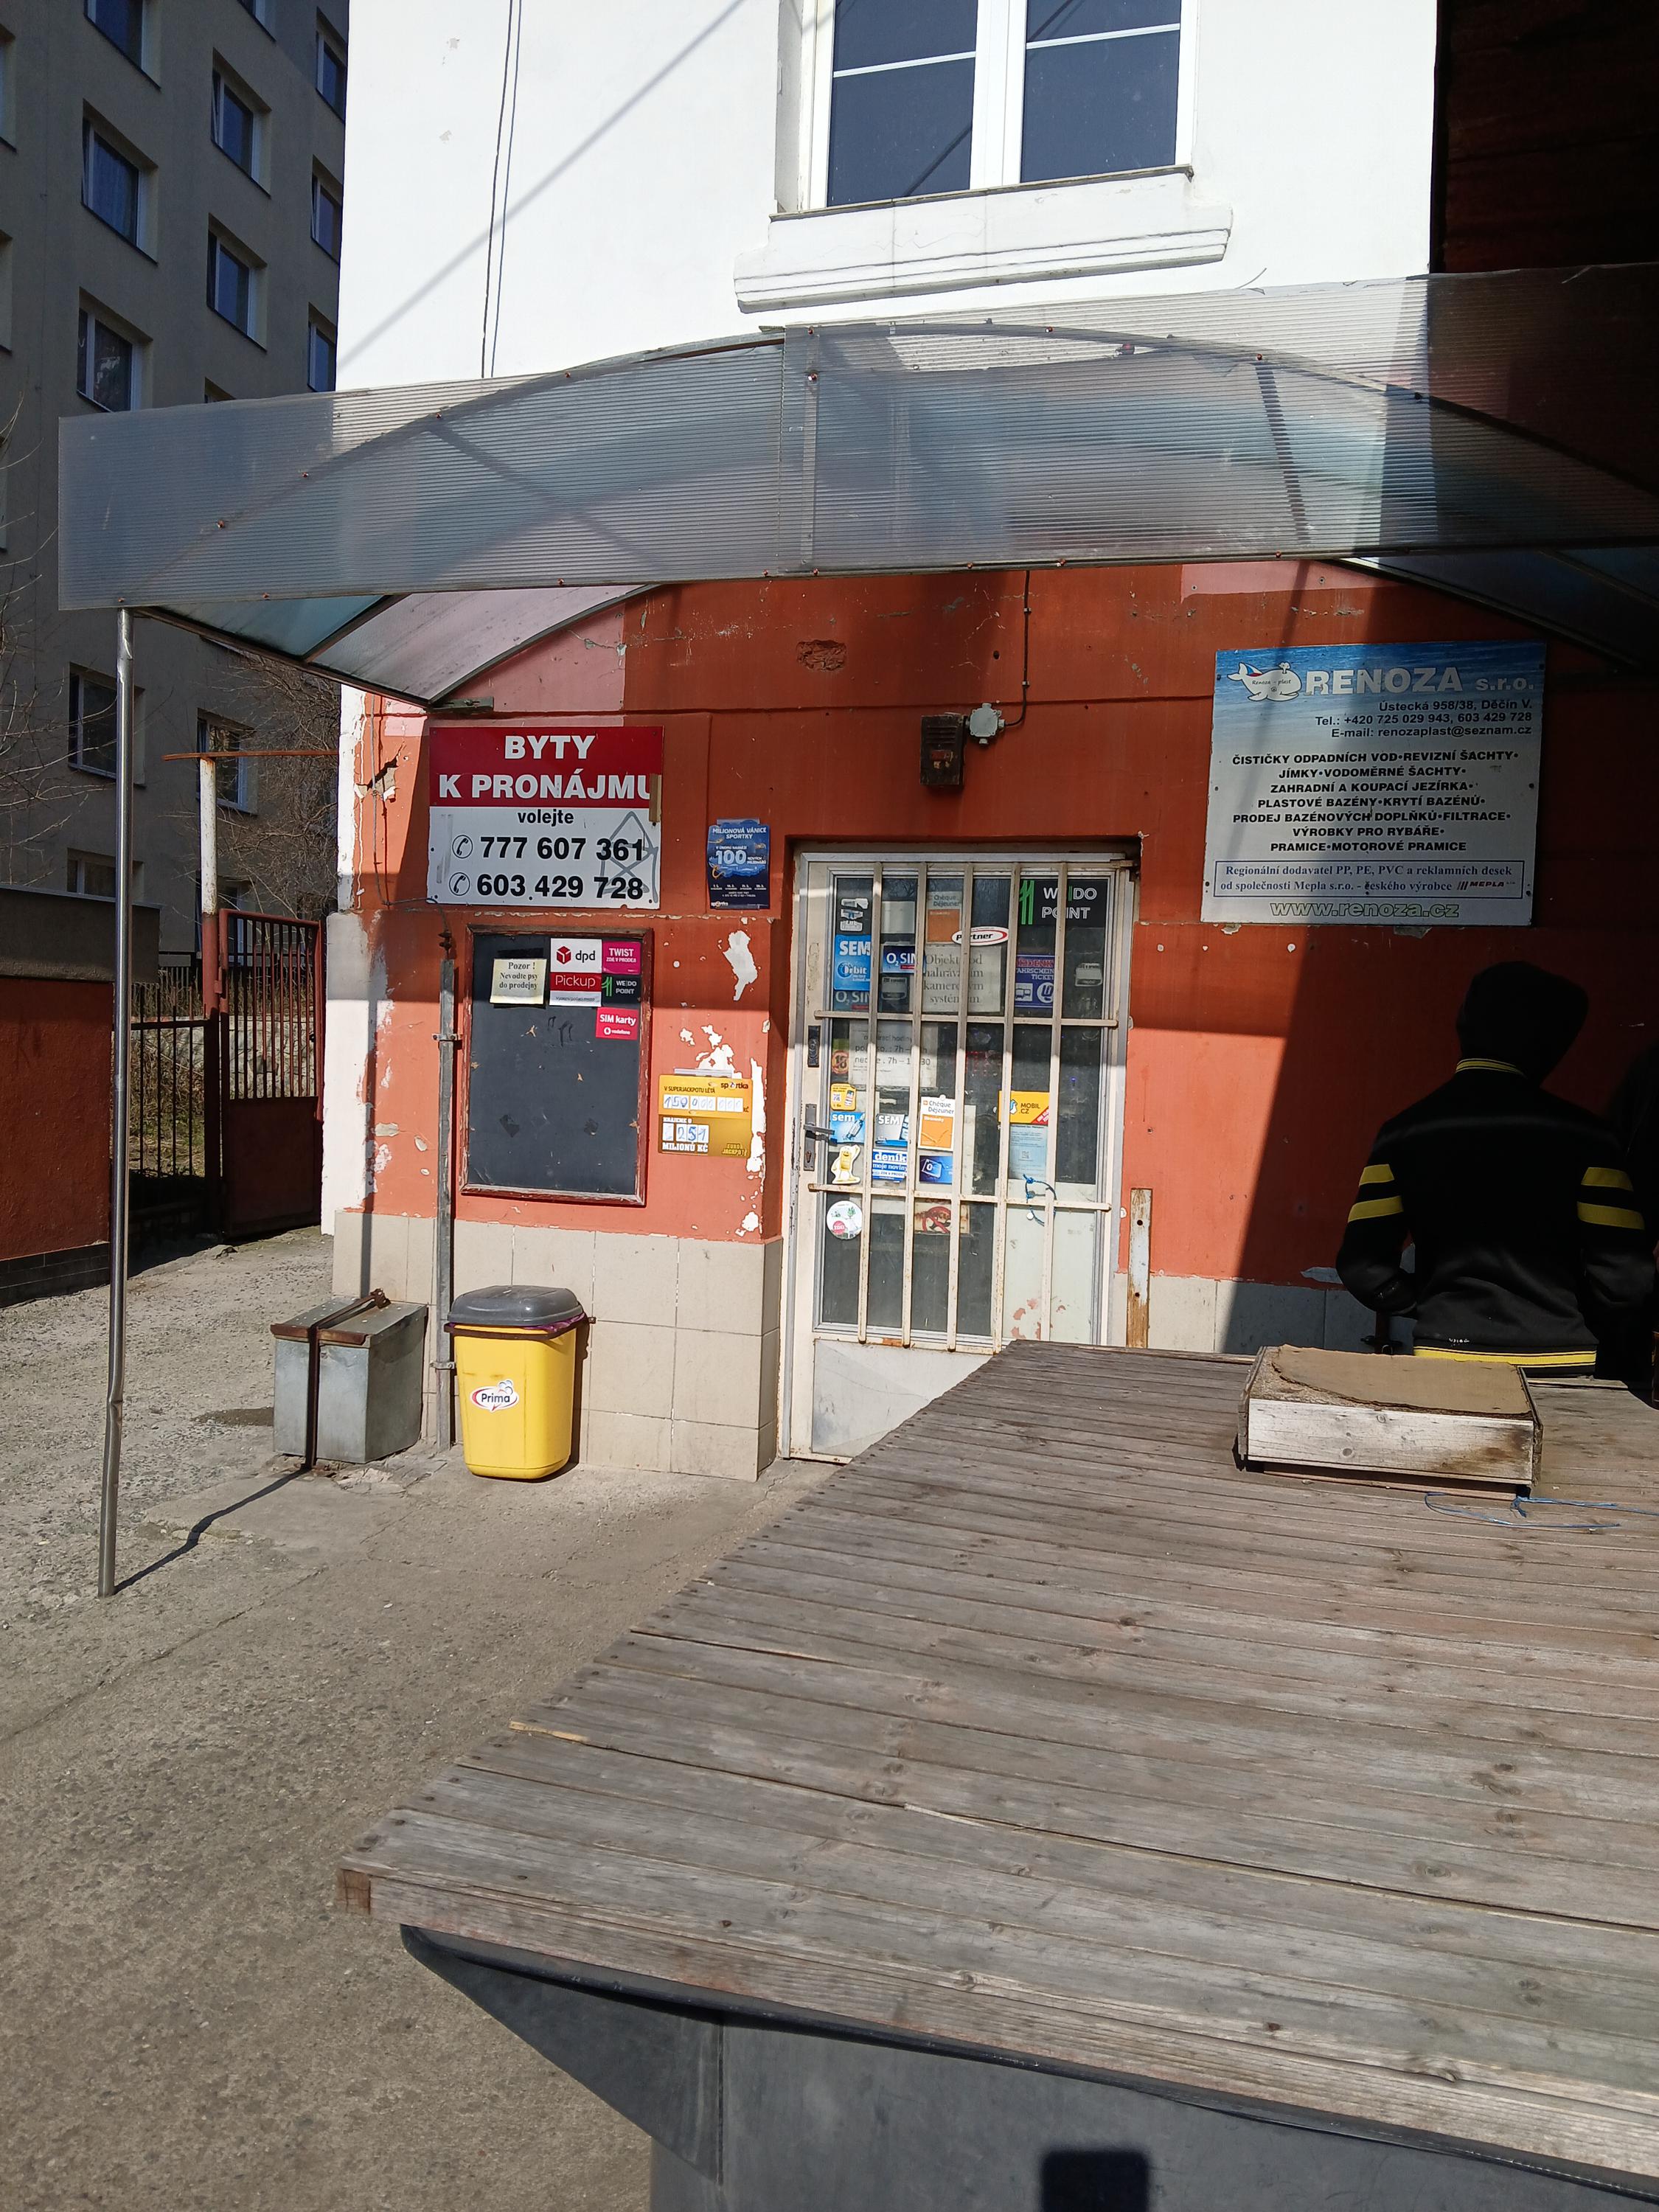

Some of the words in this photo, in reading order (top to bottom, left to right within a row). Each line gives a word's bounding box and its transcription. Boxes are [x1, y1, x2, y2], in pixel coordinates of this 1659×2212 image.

[1304, 667, 1463, 696] RENOZA
[1475, 677, 1534, 691] s.r.o.
[1379, 700, 1428, 712] Ústecká
[1433, 701, 1477, 712] 958/38,
[1481, 700, 1517, 709] Děčín
[1522, 700, 1532, 709] V.
[1315, 716, 1340, 726] Tel.:
[1344, 715, 1373, 725] +420
[1377, 714, 1399, 724] 725
[1402, 714, 1424, 723] 029
[1427, 713, 1453, 724] 943,
[1457, 713, 1479, 723] 603
[1484, 712, 1506, 722] 429
[1510, 712, 1532, 722] 728
[1332, 727, 1374, 737] E-mail:
[1378, 726, 1531, 737] renozaplast@seznam.cz
[504, 735, 596, 759] BYTY
[1232, 754, 1290, 765] ČISTIČKY
[1293, 751, 1367, 763] ODPADNÍCH
[439, 774, 462, 798] K
[472, 768, 650, 799] PRONÁJMU
[1270, 781, 1335, 793] ZAHRADNÍ
[1338, 784, 1347, 792] A
[1351, 780, 1408, 792] KOUPACÍ
[1258, 796, 1322, 808] PLASTOVÉ
[518, 809, 574, 827] volejte
[1233, 814, 1281, 823] PRODEJ
[1284, 811, 1371, 822] BAZÉNOVÝCH
[1293, 826, 1354, 837] VÝROBKY
[1357, 827, 1383, 836] PRO
[480, 837, 528, 858] 777
[537, 838, 586, 860] 607
[596, 838, 643, 861] 361
[1408, 842, 1467, 851] PRAMICE
[715, 850, 746, 865] 100
[1225, 866, 1279, 877] Regionální
[1282, 866, 1332, 875] dodavatel
[1336, 866, 1353, 876] PP,
[1356, 866, 1375, 876] PE,
[1378, 866, 1404, 874] PVC
[1416, 865, 1478, 875] reklamních
[1481, 866, 1512, 875] desek
[476, 874, 526, 897] 603
[535, 875, 584, 898] 429
[594, 877, 644, 900] 728
[1220, 881, 1232, 890] od
[1235, 880, 1290, 892] společnosti
[1294, 881, 1326, 892] Mepla
[1365, 881, 1406, 891] českého
[1409, 881, 1452, 892] výrobce
[1270, 902, 1459, 917] www.renoza.cz
[575, 950, 596, 963] dpd
[608, 948, 634, 957] TWIST
[508, 961, 531, 970] Pozor
[509, 982, 538, 990] prodejny
[555, 975, 596, 989] Pickup
[599, 1014, 614, 1023] SIM
[615, 1015, 637, 1026] karty
[832, 1113, 855, 1121] sem
[877, 1115, 900, 1124] SEM
[662, 1142, 695, 1152] MILIONŮ
[697, 1144, 709, 1152] KČ
[874, 1151, 907, 1162] deník
[481, 1392, 510, 1403] Prima
